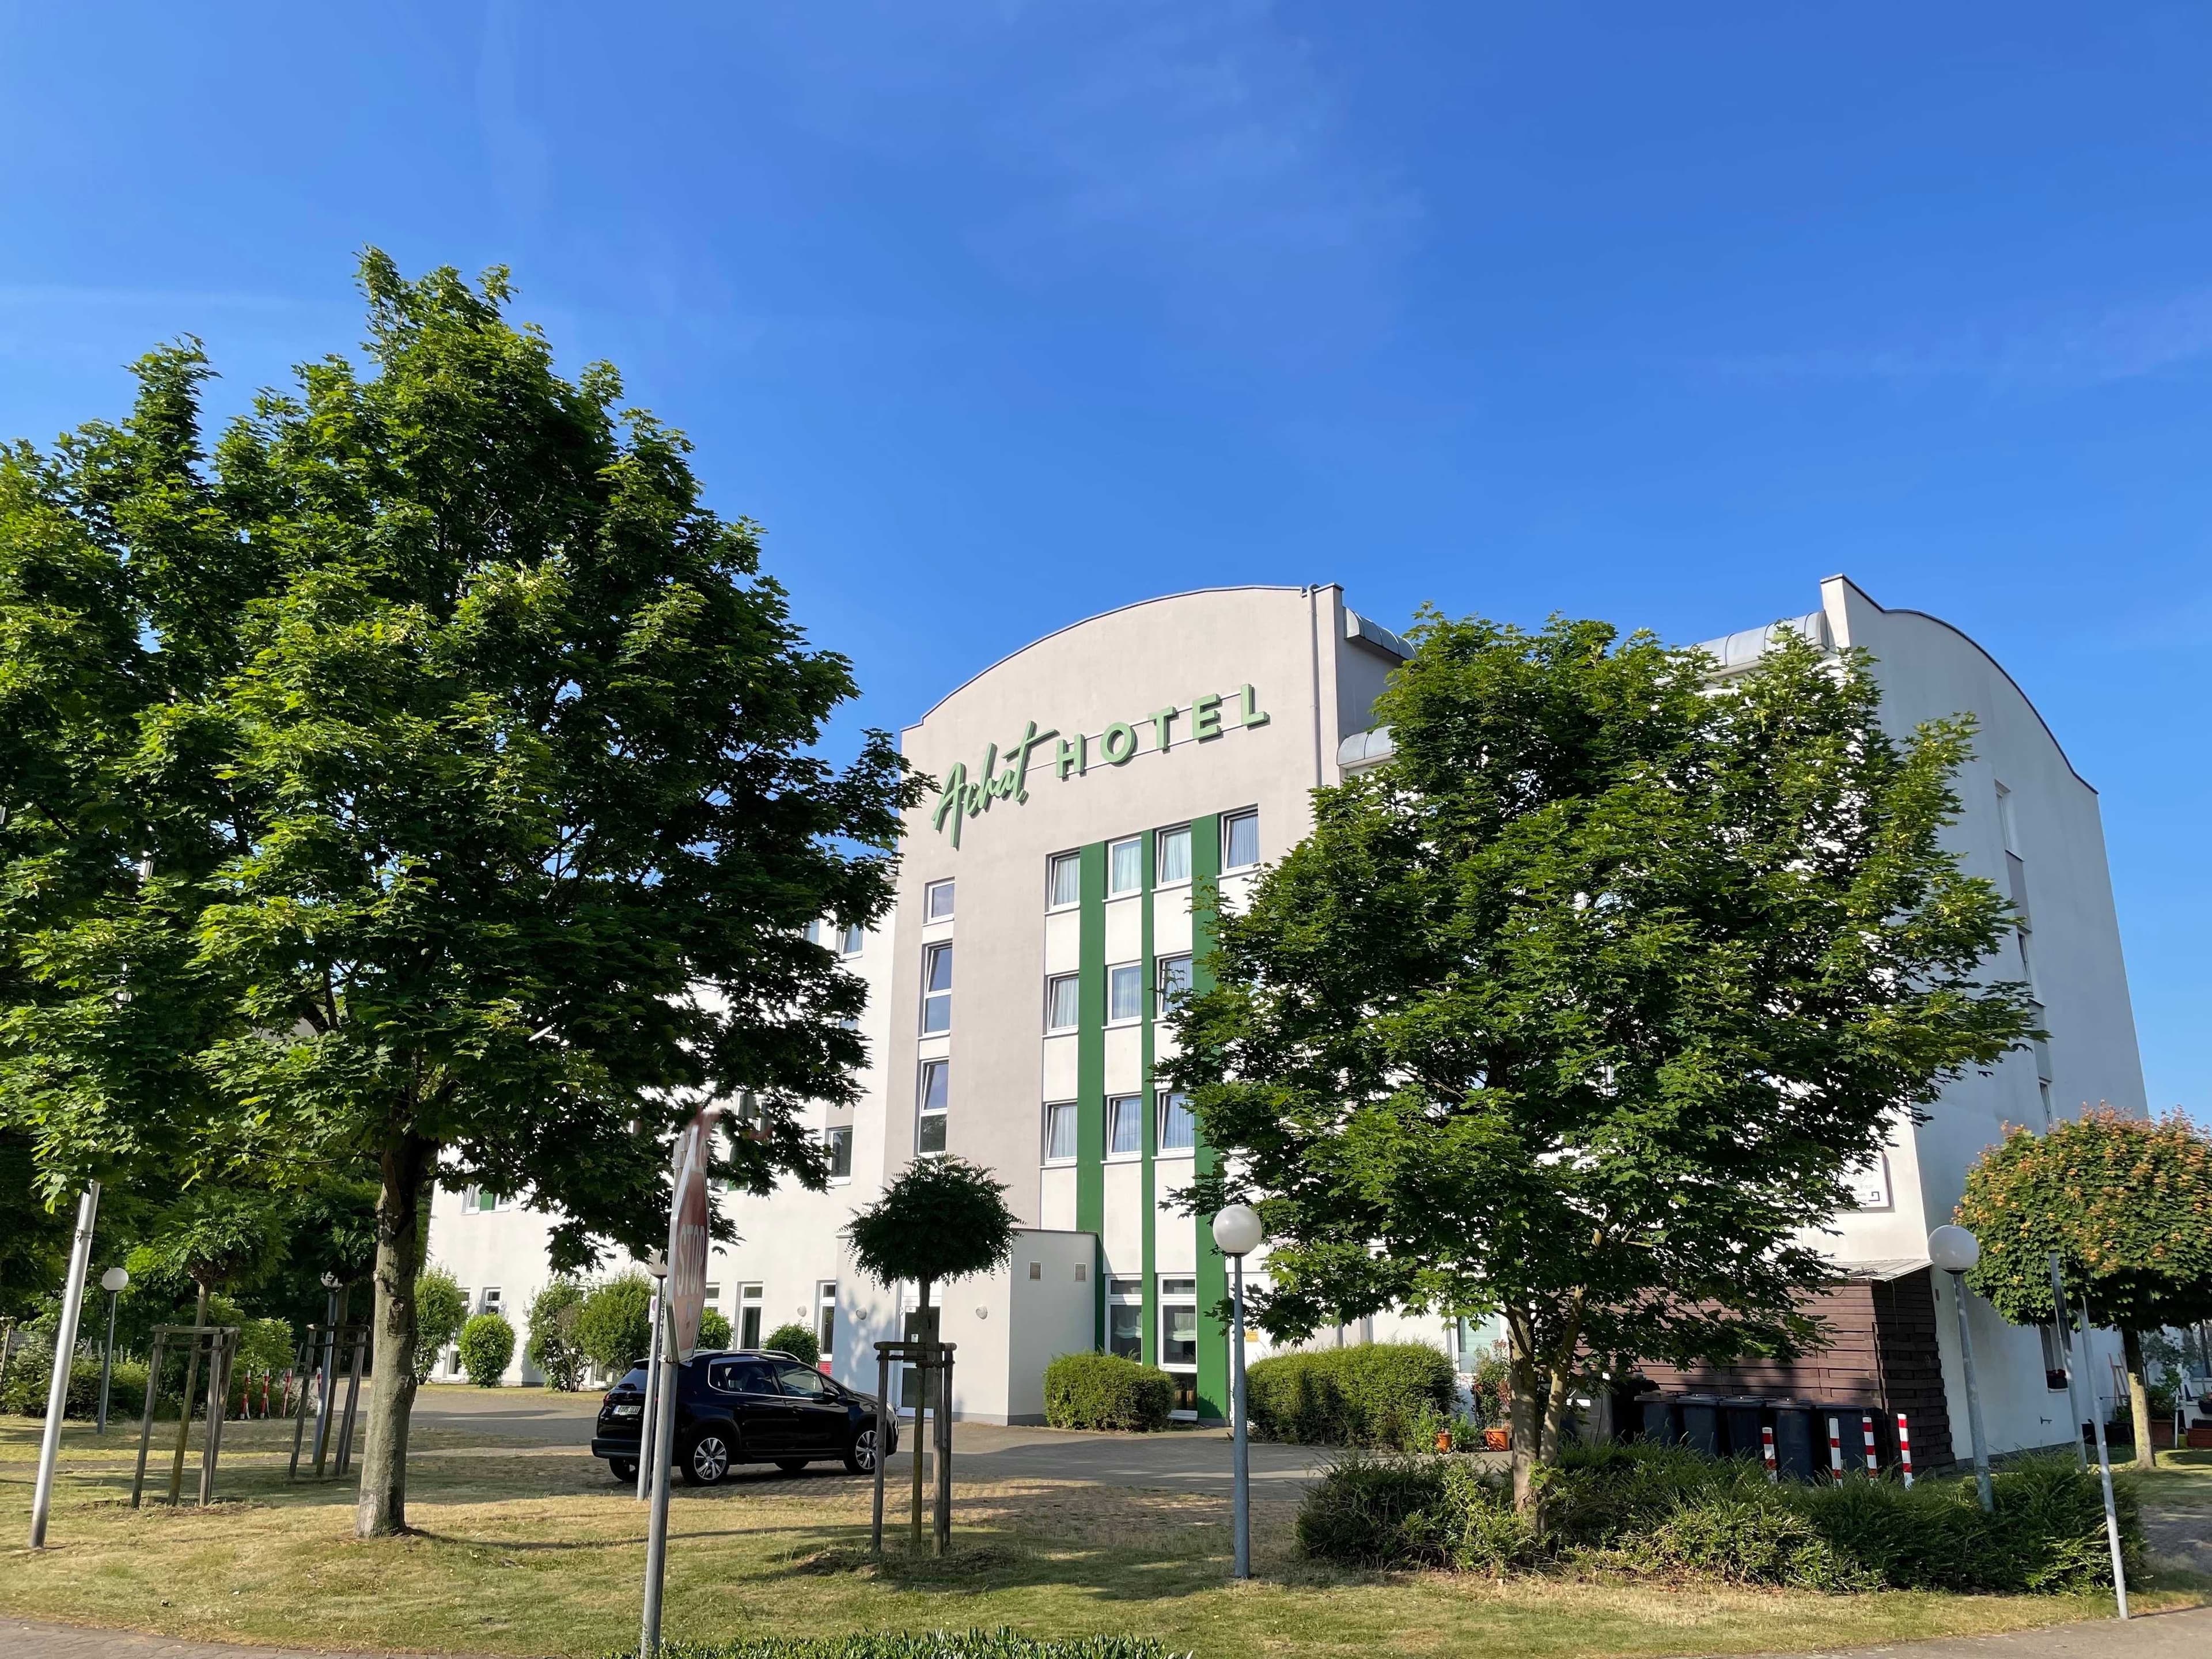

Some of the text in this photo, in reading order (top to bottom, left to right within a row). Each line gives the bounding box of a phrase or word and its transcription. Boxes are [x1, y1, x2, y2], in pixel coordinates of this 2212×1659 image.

[932, 684, 1269, 849] Achat HOTEL
[677, 1224, 705, 1297] STOP
